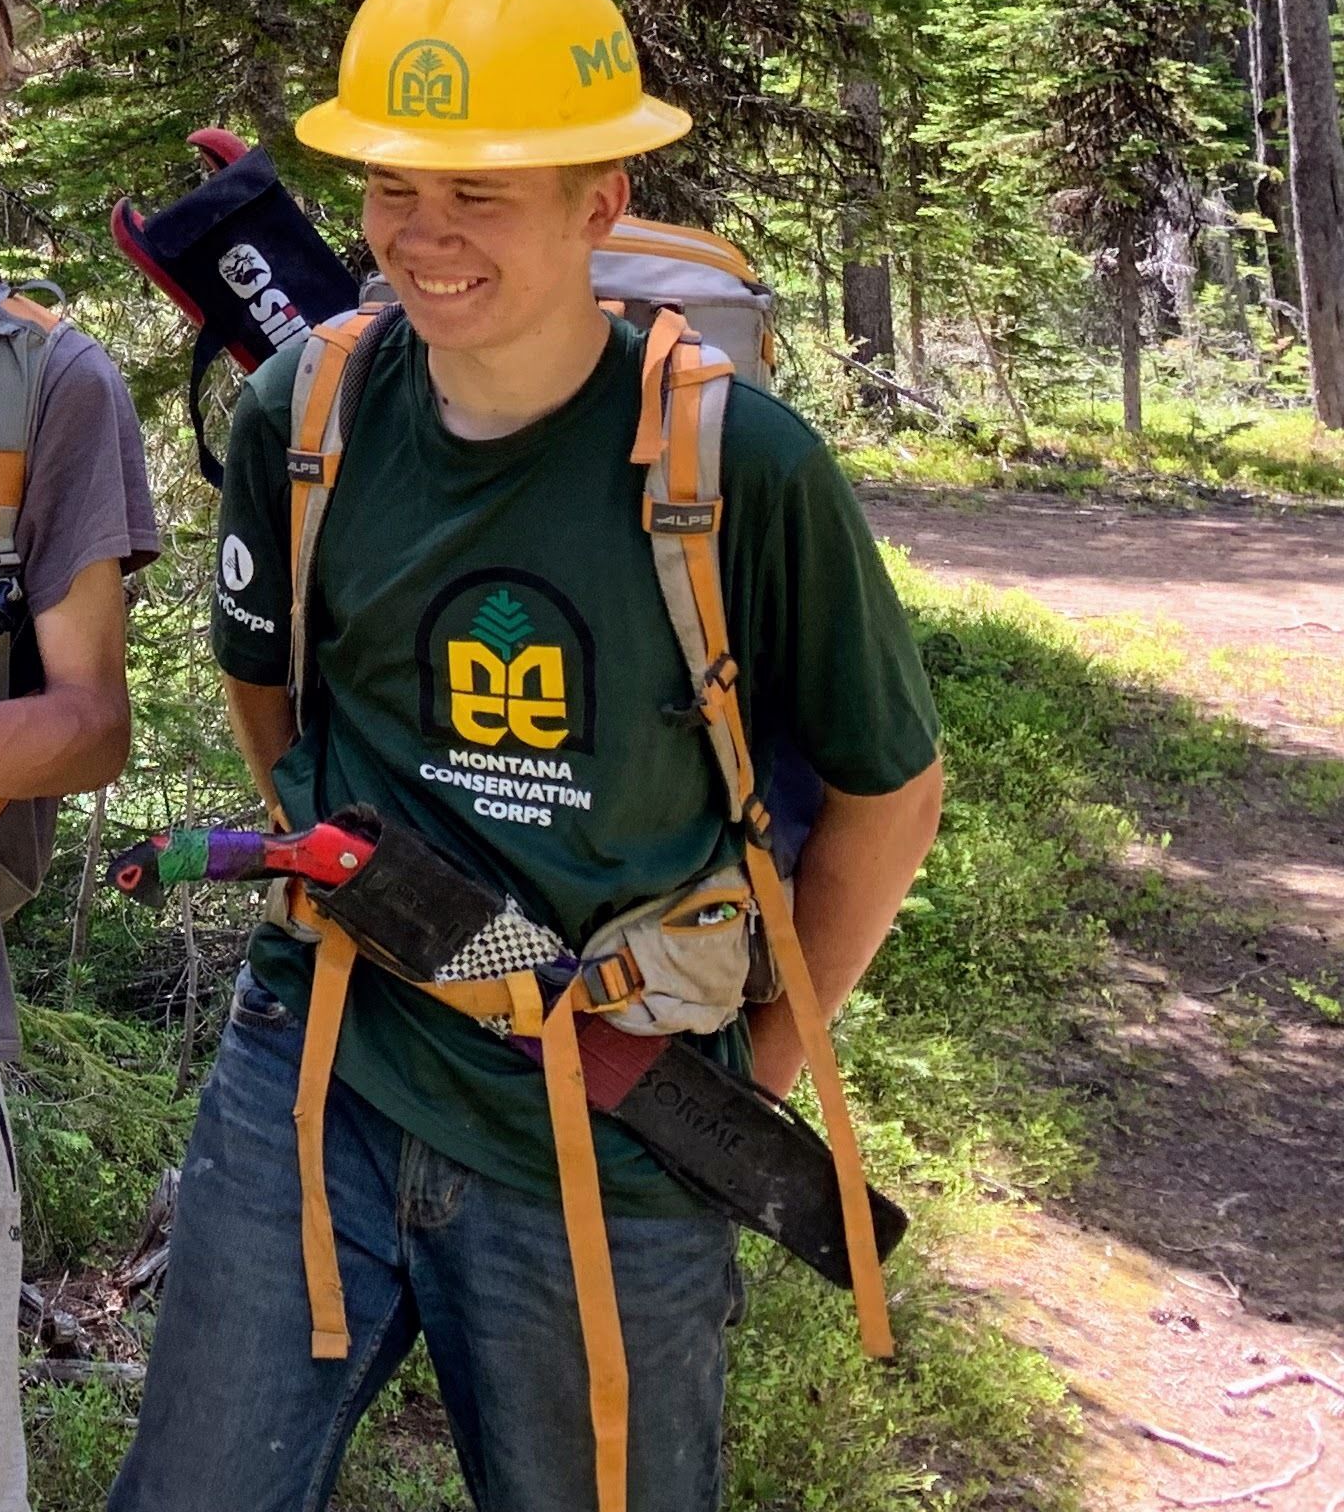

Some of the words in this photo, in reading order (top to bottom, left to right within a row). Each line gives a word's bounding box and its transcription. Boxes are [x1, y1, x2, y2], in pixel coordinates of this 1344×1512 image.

[569, 31, 635, 88] MC
[656, 514, 712, 526] ALPS
[449, 749, 573, 781] MONTANA
[420, 763, 591, 811] CONSERVATION
[474, 797, 552, 828] CORPS
